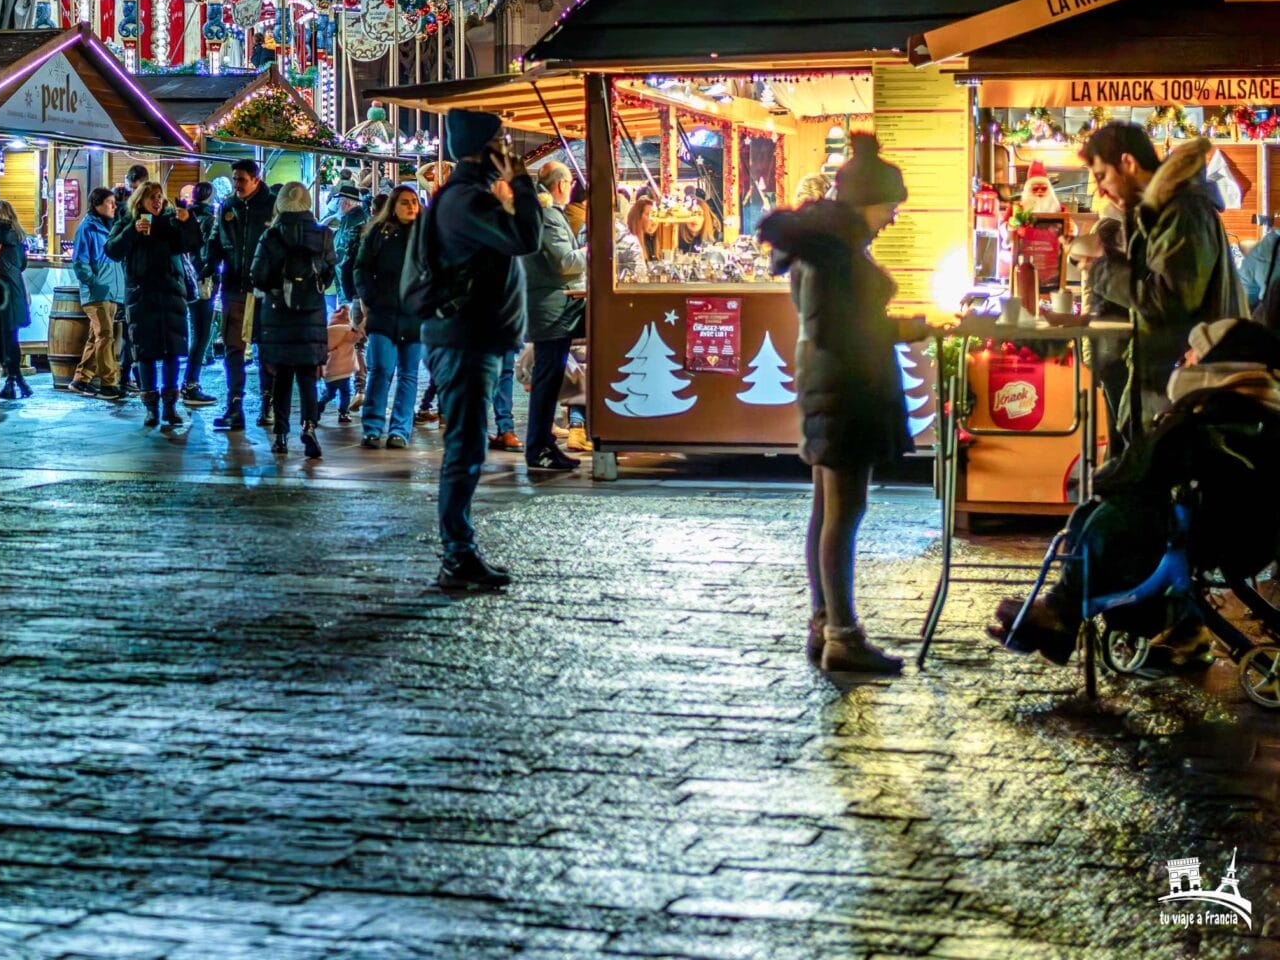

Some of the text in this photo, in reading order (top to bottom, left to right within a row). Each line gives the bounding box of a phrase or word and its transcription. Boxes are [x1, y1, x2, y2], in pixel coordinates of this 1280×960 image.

[40, 73, 78, 124] perle
[1071, 78, 1280, 103] LA KNACK 100% ALSACE
